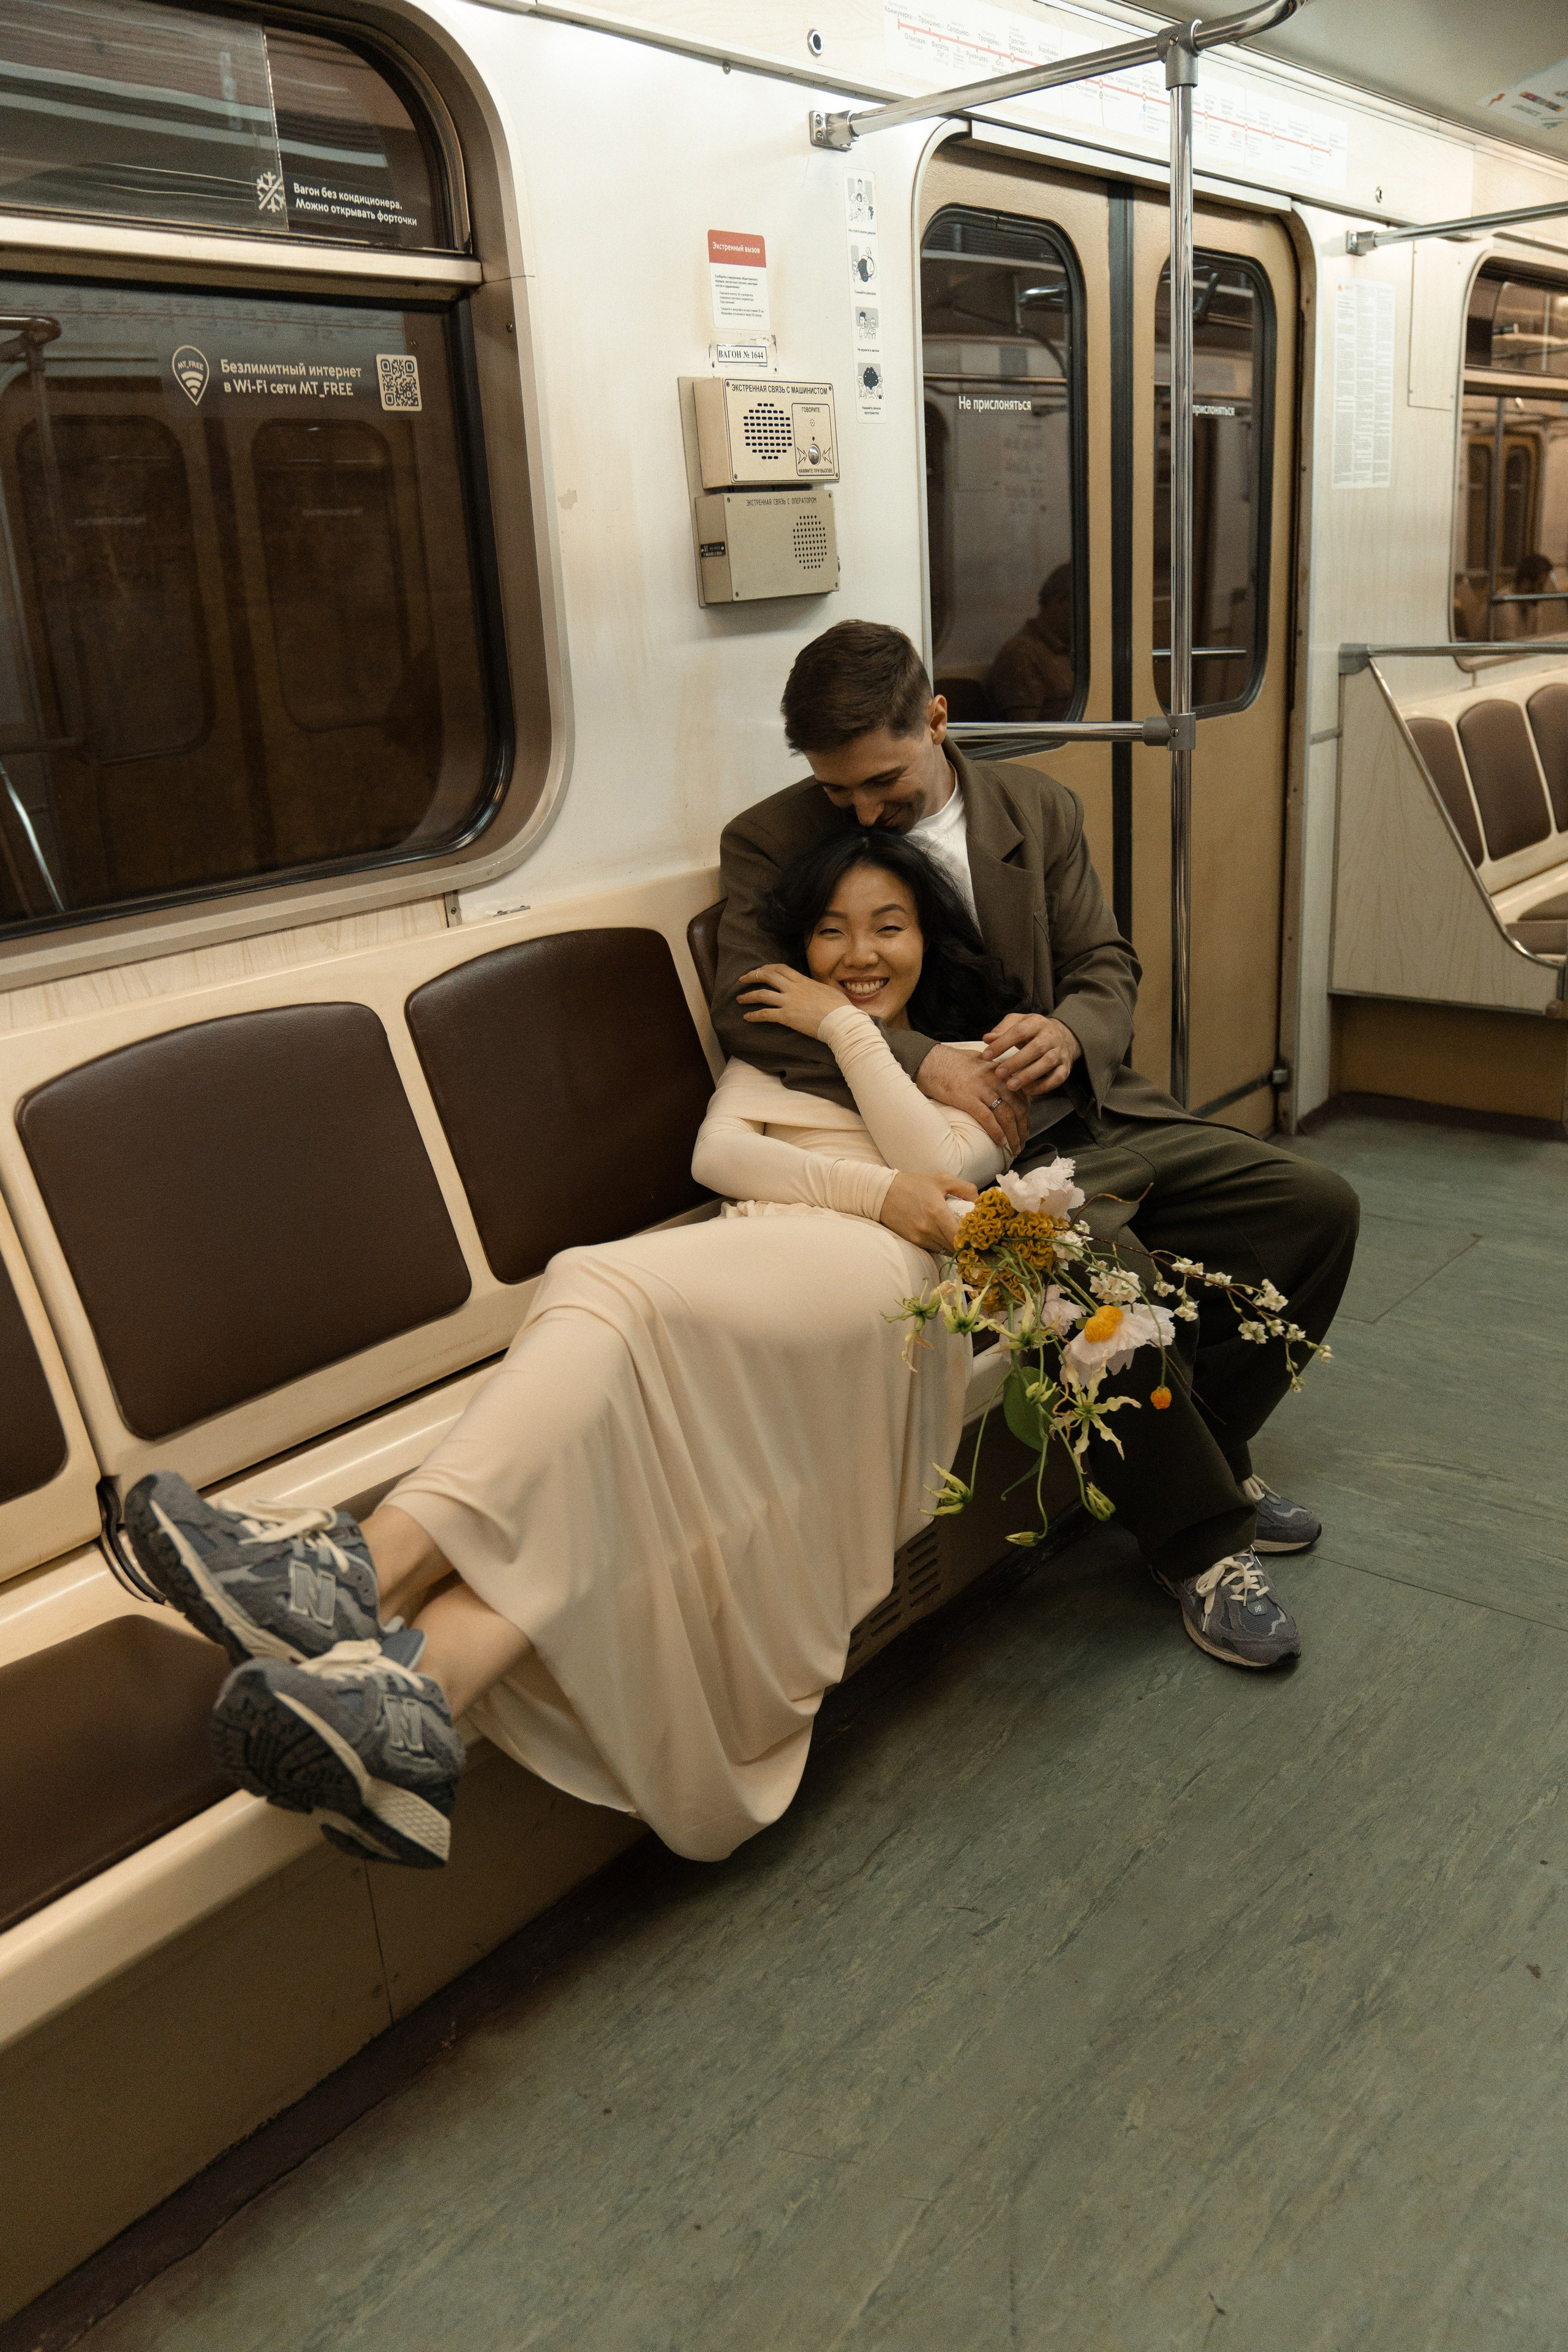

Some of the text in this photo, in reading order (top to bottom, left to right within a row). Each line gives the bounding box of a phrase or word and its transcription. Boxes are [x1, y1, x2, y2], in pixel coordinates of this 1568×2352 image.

[884, 5, 912, 19] Коммунарка
[918, 15, 941, 28] Прокшино
[947, 24, 969, 36] Саларьево
[905, 32, 925, 43] Ольховая
[932, 41, 949, 51] Филатов
[293, 183, 402, 209] Вагон без кондиционера.
[296, 198, 417, 226] Можно открывать форточки
[712, 241, 744, 252] Экстренный
[718, 350, 742, 358] ВАГОН
[221, 359, 361, 380] Безлимитный интернет
[224, 379, 354, 398] в Wi-Fi сети MT_FREE
[959, 396, 1031, 412] Не прислоняться
